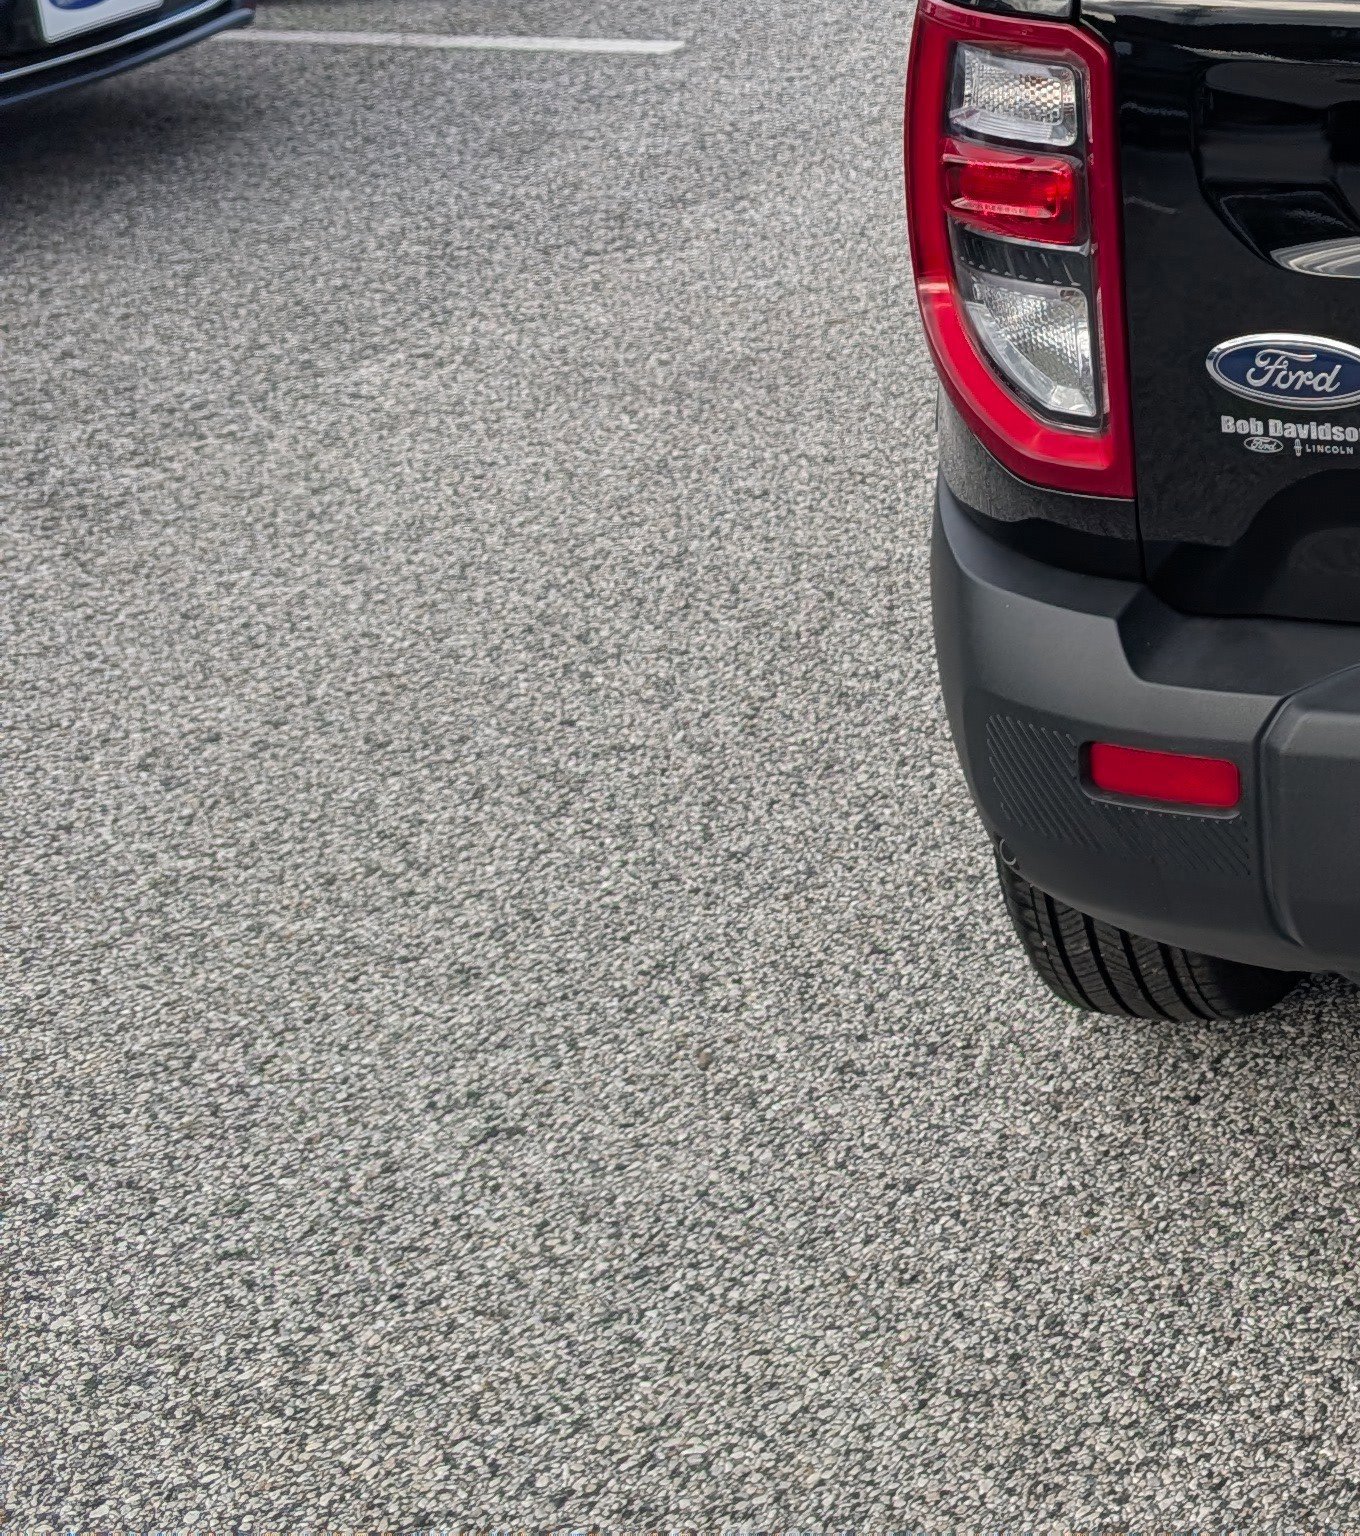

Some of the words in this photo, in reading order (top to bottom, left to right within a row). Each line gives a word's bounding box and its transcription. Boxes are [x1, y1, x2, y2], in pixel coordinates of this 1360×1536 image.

[1247, 348, 1341, 393] Ford
[1221, 415, 1263, 435] Bob
[1305, 444, 1354, 455] LINCOLN
